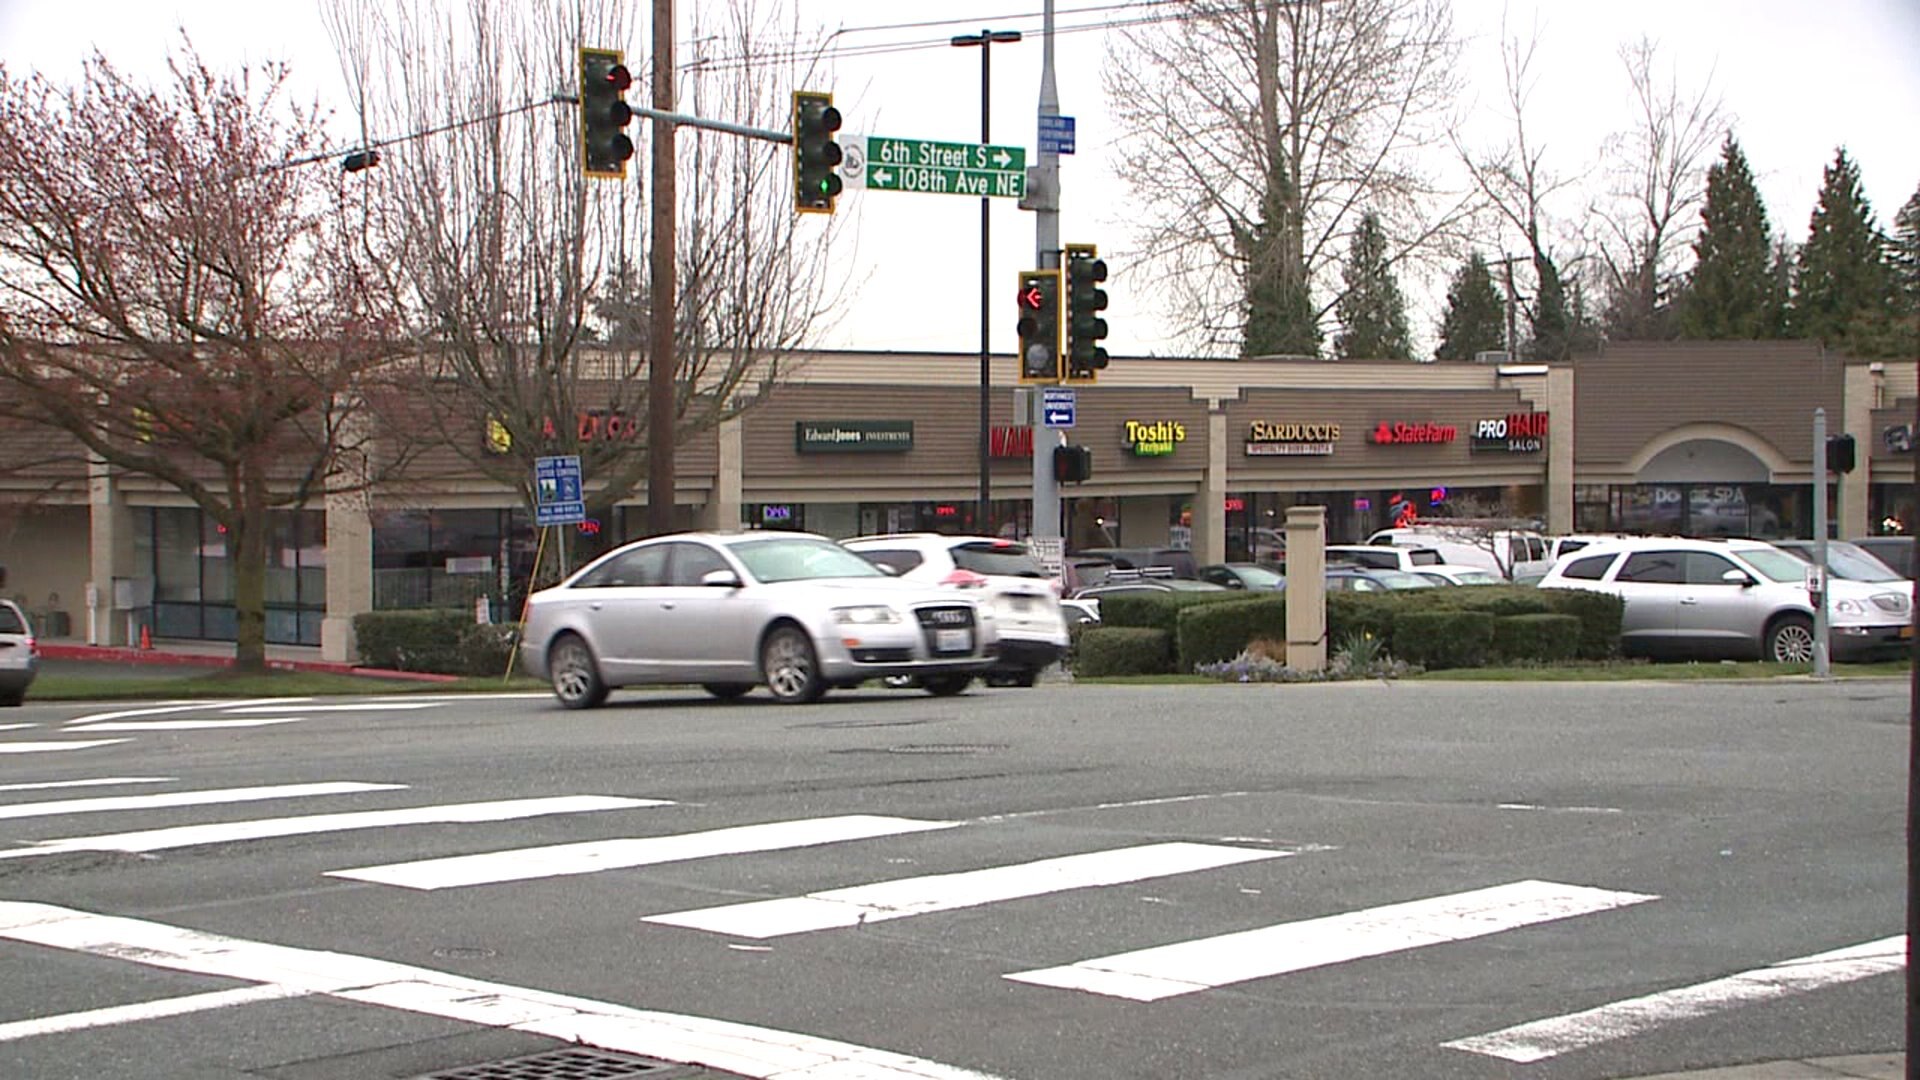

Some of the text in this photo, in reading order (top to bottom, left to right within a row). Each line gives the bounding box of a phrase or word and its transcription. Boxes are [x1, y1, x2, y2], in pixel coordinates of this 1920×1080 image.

[880, 140, 987, 168] 6th Street S
[899, 167, 1020, 195] 108th Ave NE
[1126, 420, 1185, 441] Toshi's
[1478, 413, 1548, 438] PRO HAIR
[1508, 440, 1541, 451] SALON
[1714, 487, 1746, 504] SPA
